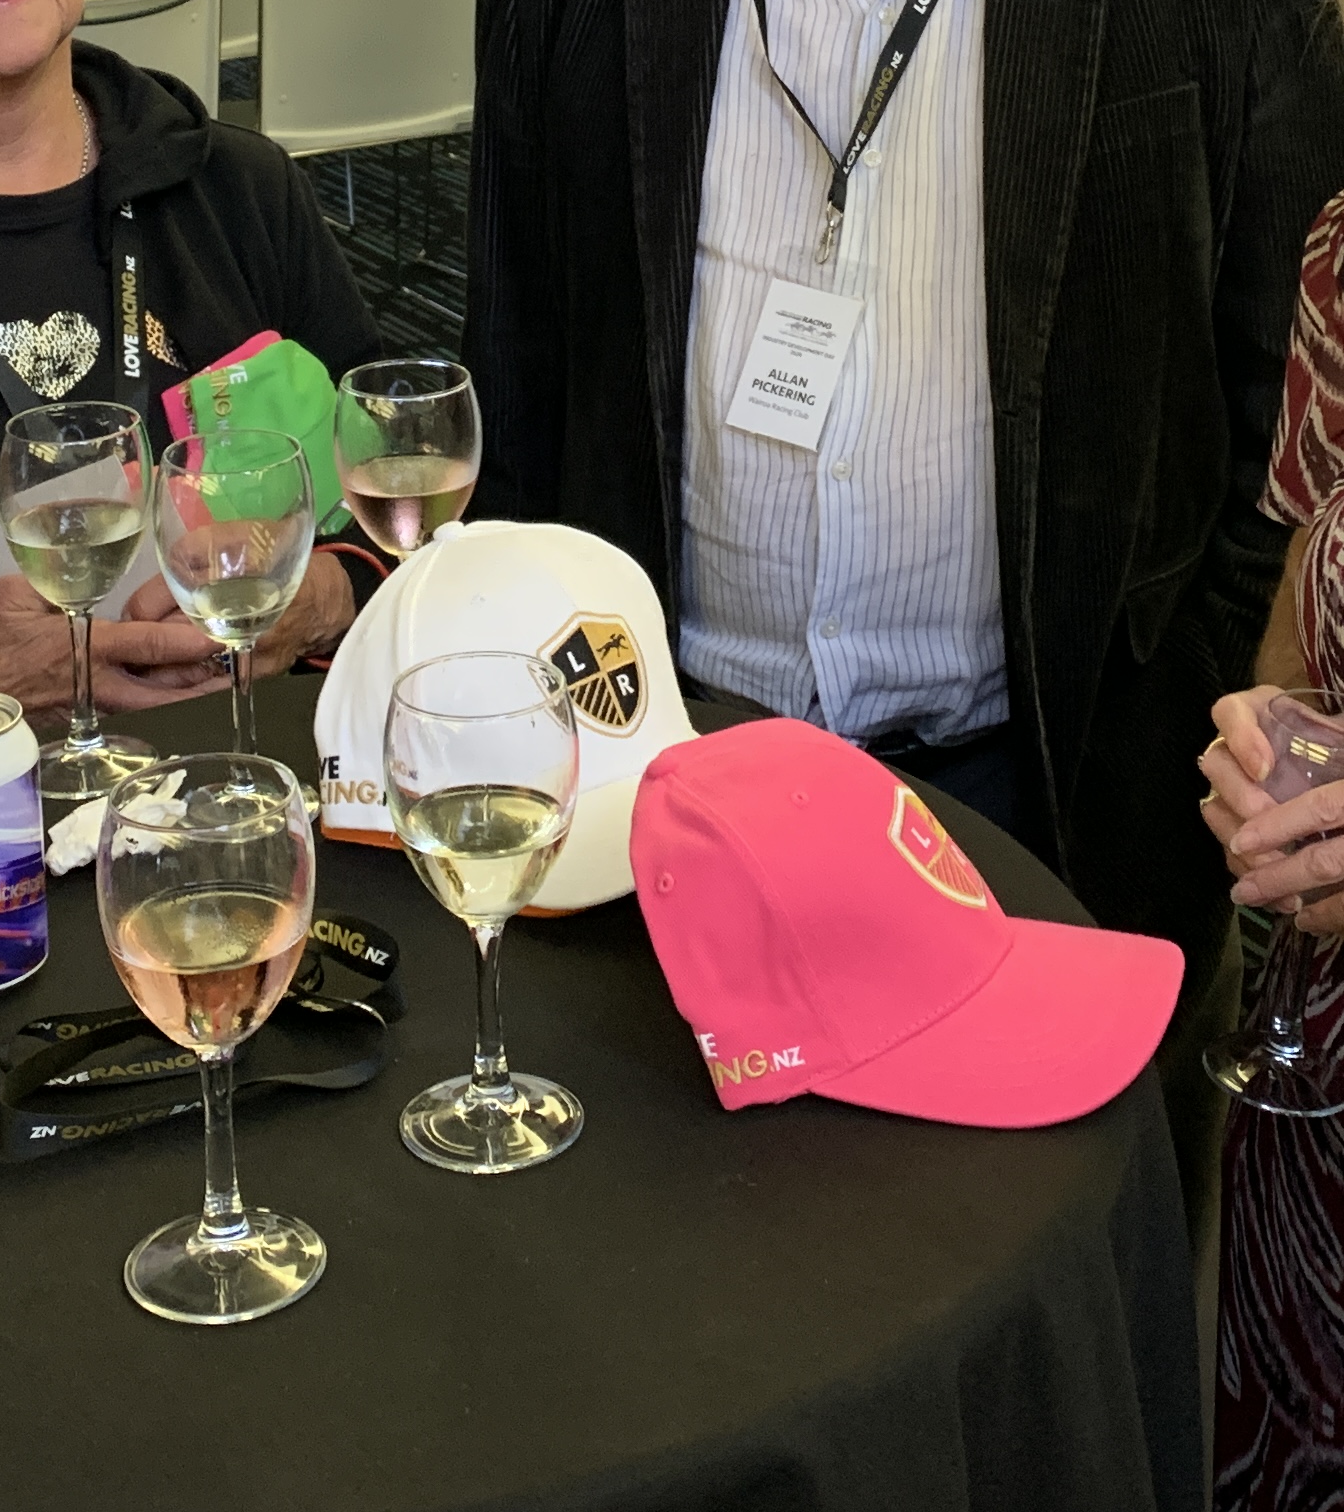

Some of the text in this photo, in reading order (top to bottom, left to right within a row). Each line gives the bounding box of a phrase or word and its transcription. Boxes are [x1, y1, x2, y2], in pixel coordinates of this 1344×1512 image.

[842, 50, 904, 175] LOVERACING.NZ
[121, 255, 141, 378] LOVERACING.NZ
[802, 316, 833, 330] RACING
[768, 368, 809, 388] ALLAN
[752, 378, 816, 406] PICKERING
[772, 403, 792, 417] Racing
[794, 409, 810, 420] Club
[567, 651, 586, 673] L
[616, 674, 635, 696] R
[696, 1032, 718, 1058] E
